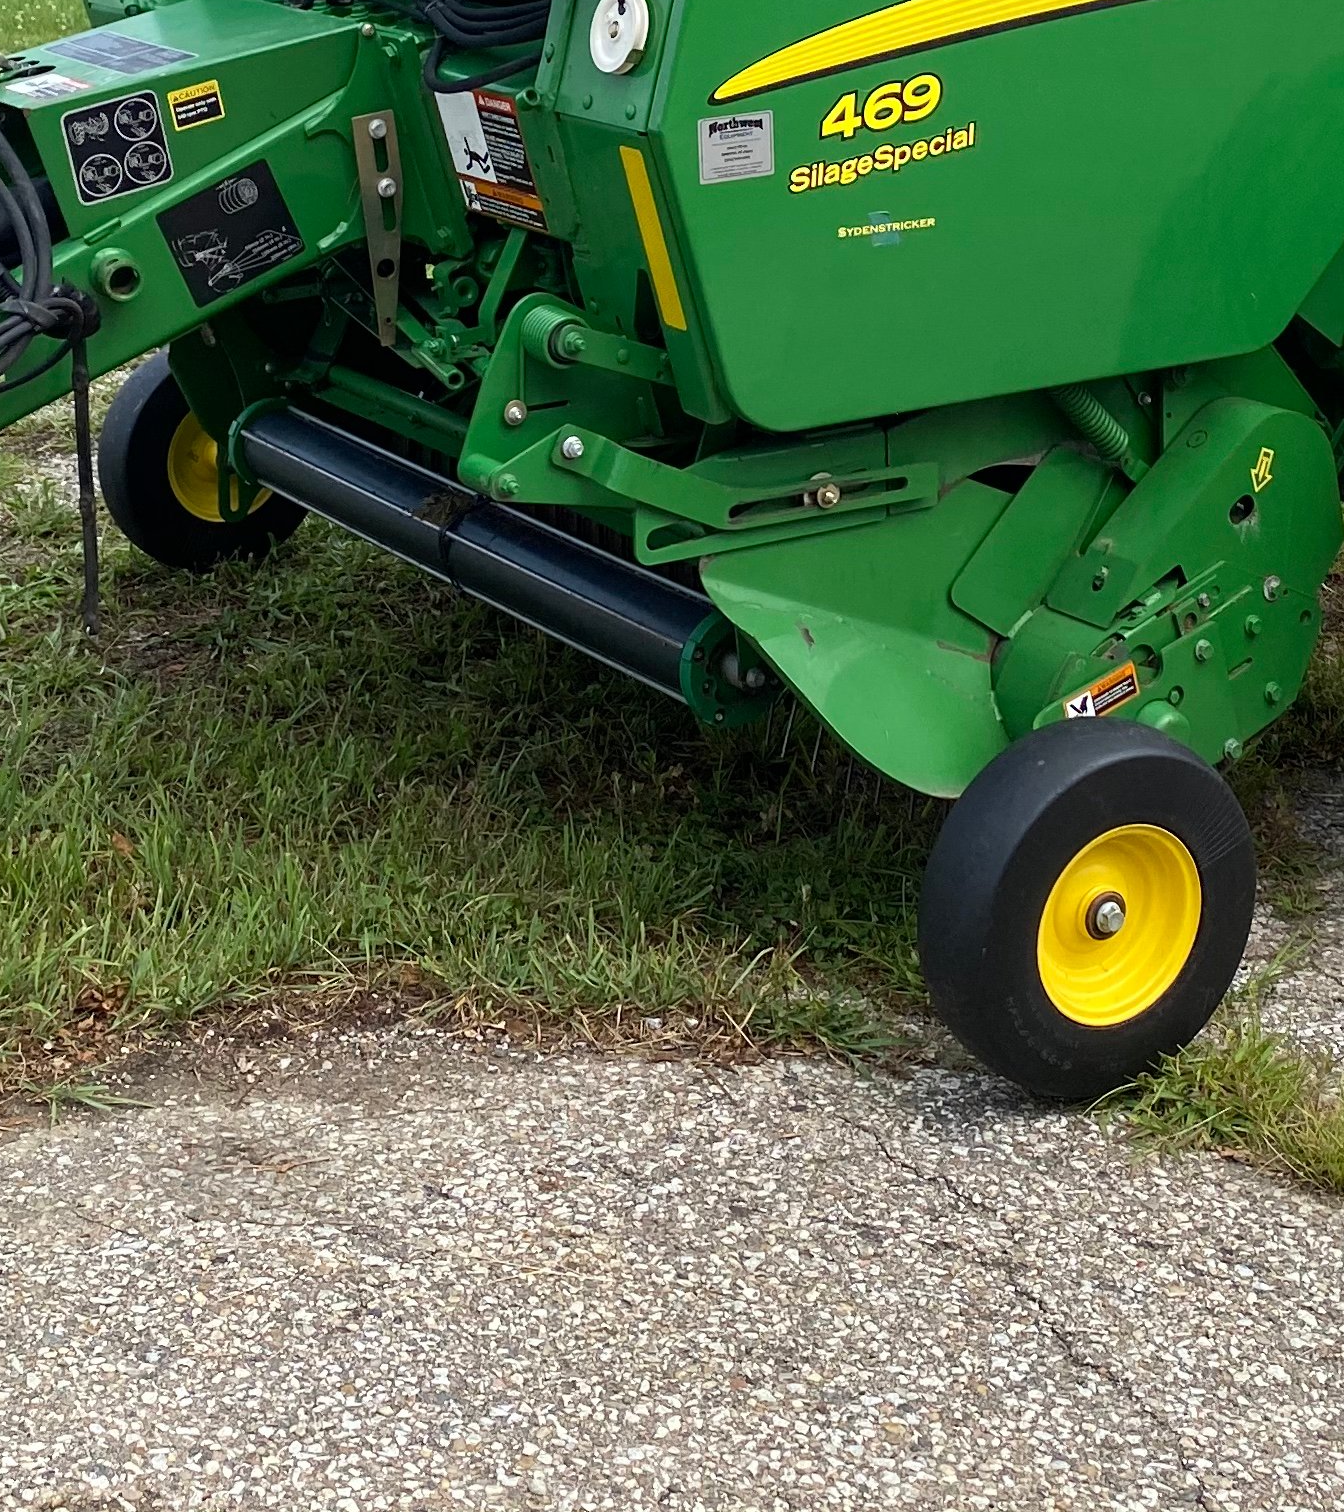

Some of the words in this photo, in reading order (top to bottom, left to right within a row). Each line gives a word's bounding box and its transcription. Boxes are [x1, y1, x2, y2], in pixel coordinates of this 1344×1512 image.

[179, 84, 215, 100] CAUTION
[821, 72, 943, 140] 469
[789, 122, 976, 193] SilageSpecial
[837, 217, 936, 238] SYDENSTRICKER
